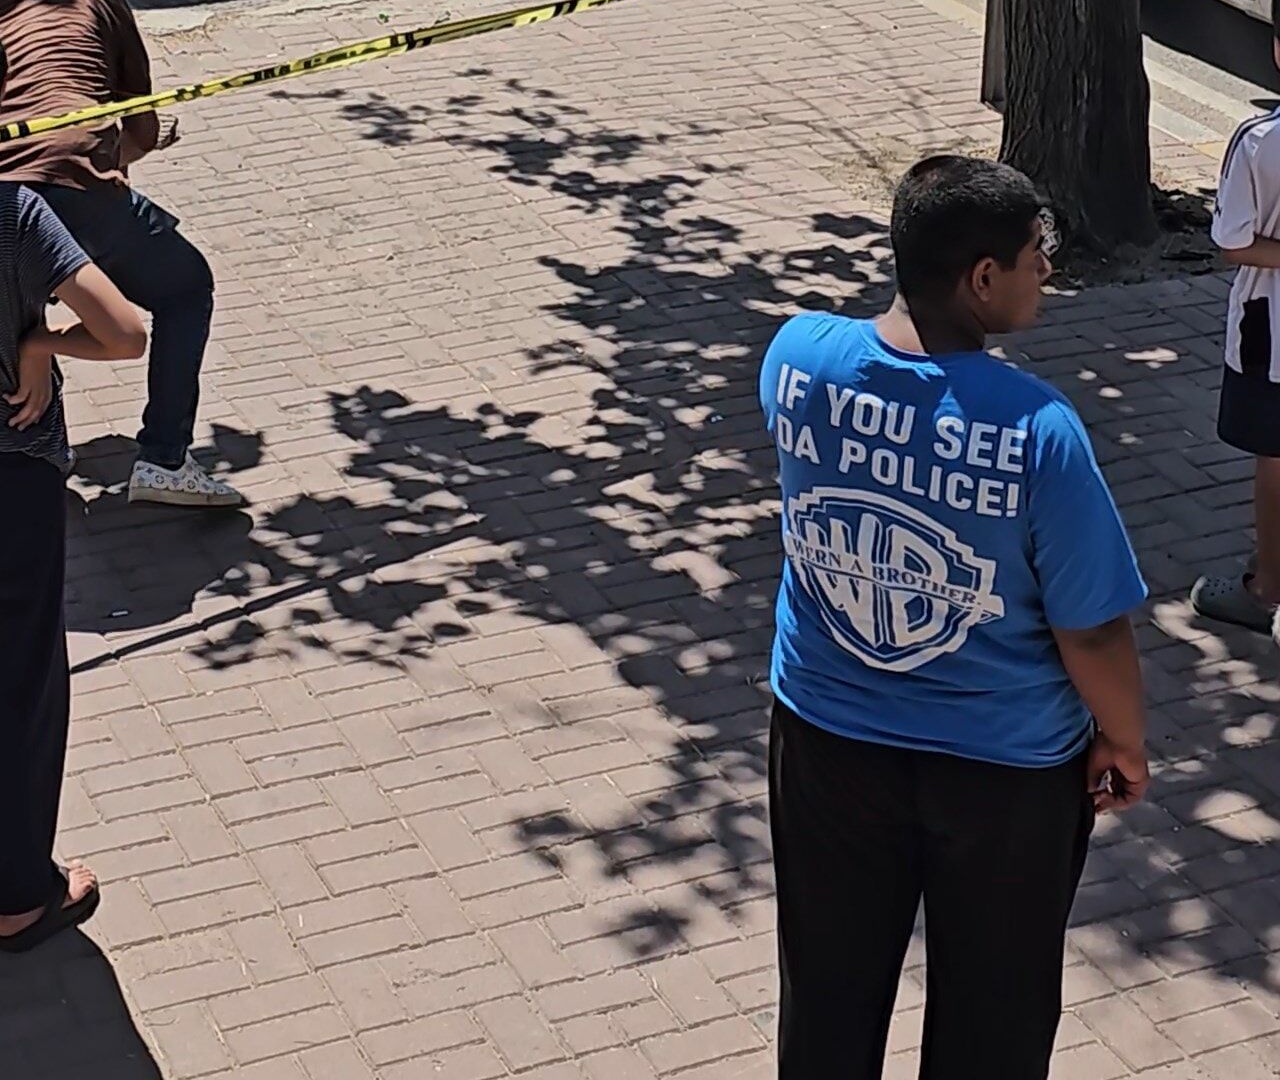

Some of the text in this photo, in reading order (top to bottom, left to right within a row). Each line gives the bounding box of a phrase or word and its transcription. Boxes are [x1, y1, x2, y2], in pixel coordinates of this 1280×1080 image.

[777, 363, 1028, 474] IF YOU SEE
[777, 413, 1020, 518] DA POLICE!
[850, 558, 864, 573] A
